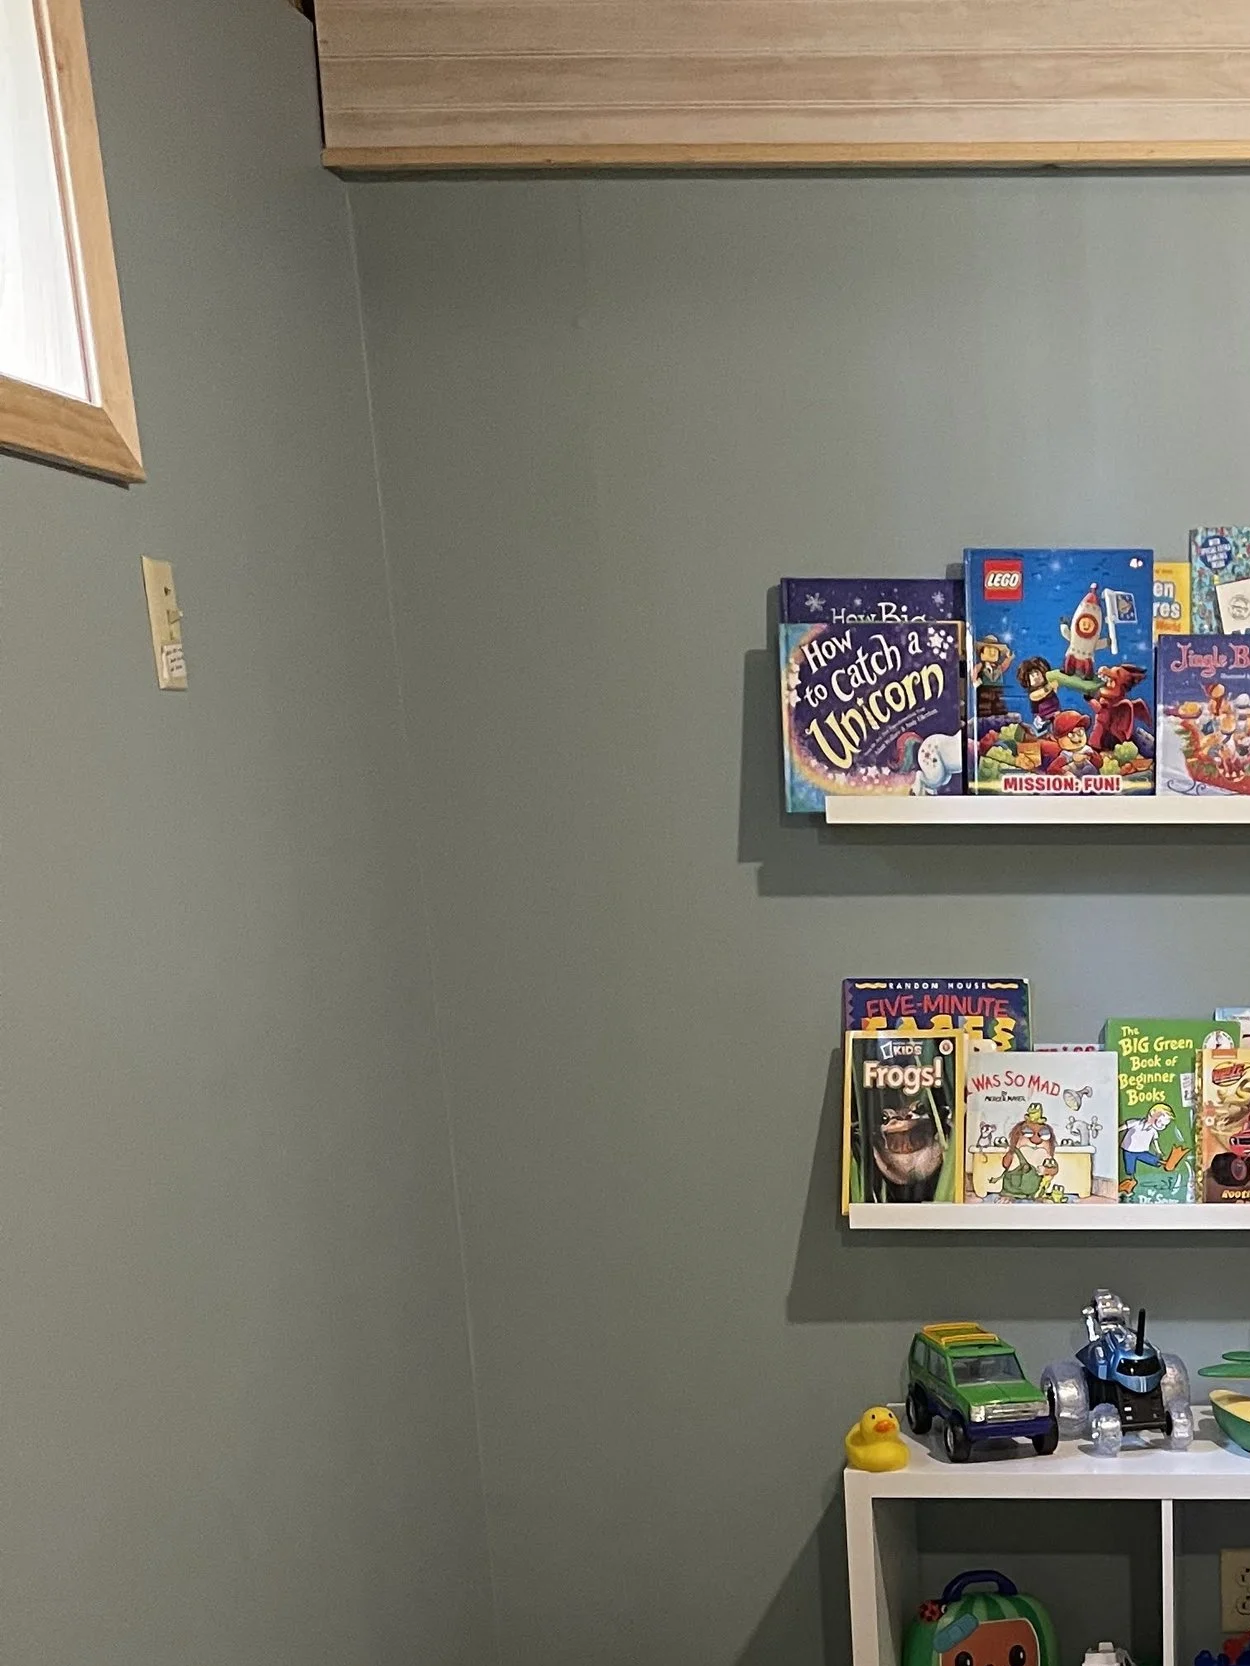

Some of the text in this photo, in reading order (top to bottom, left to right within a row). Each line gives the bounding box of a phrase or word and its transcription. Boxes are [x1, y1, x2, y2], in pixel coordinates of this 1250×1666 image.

[985, 571, 1021, 589] LEGO
[1153, 601, 1181, 619] res
[801, 628, 853, 674] How
[1170, 642, 1228, 679] Jingle
[803, 630, 923, 708] to Catch a
[804, 663, 945, 769] Unicorn
[1003, 776, 1121, 791] MISSION: FUN!
[888, 982, 987, 990] RANDOM HOUSE
[865, 993, 1010, 1019] FIVE-MINUTE
[1121, 1026, 1140, 1037] The
[893, 1045, 922, 1056] KIDS
[1118, 1036, 1149, 1057] BIG
[1153, 1036, 1194, 1052] Green
[1129, 1054, 1179, 1072] Book of
[864, 1056, 944, 1096] Frogs!
[972, 1069, 1062, 1097] WAS SO MAD
[1118, 1072, 1176, 1091] Beginner
[1126, 1087, 1167, 1107] Books
